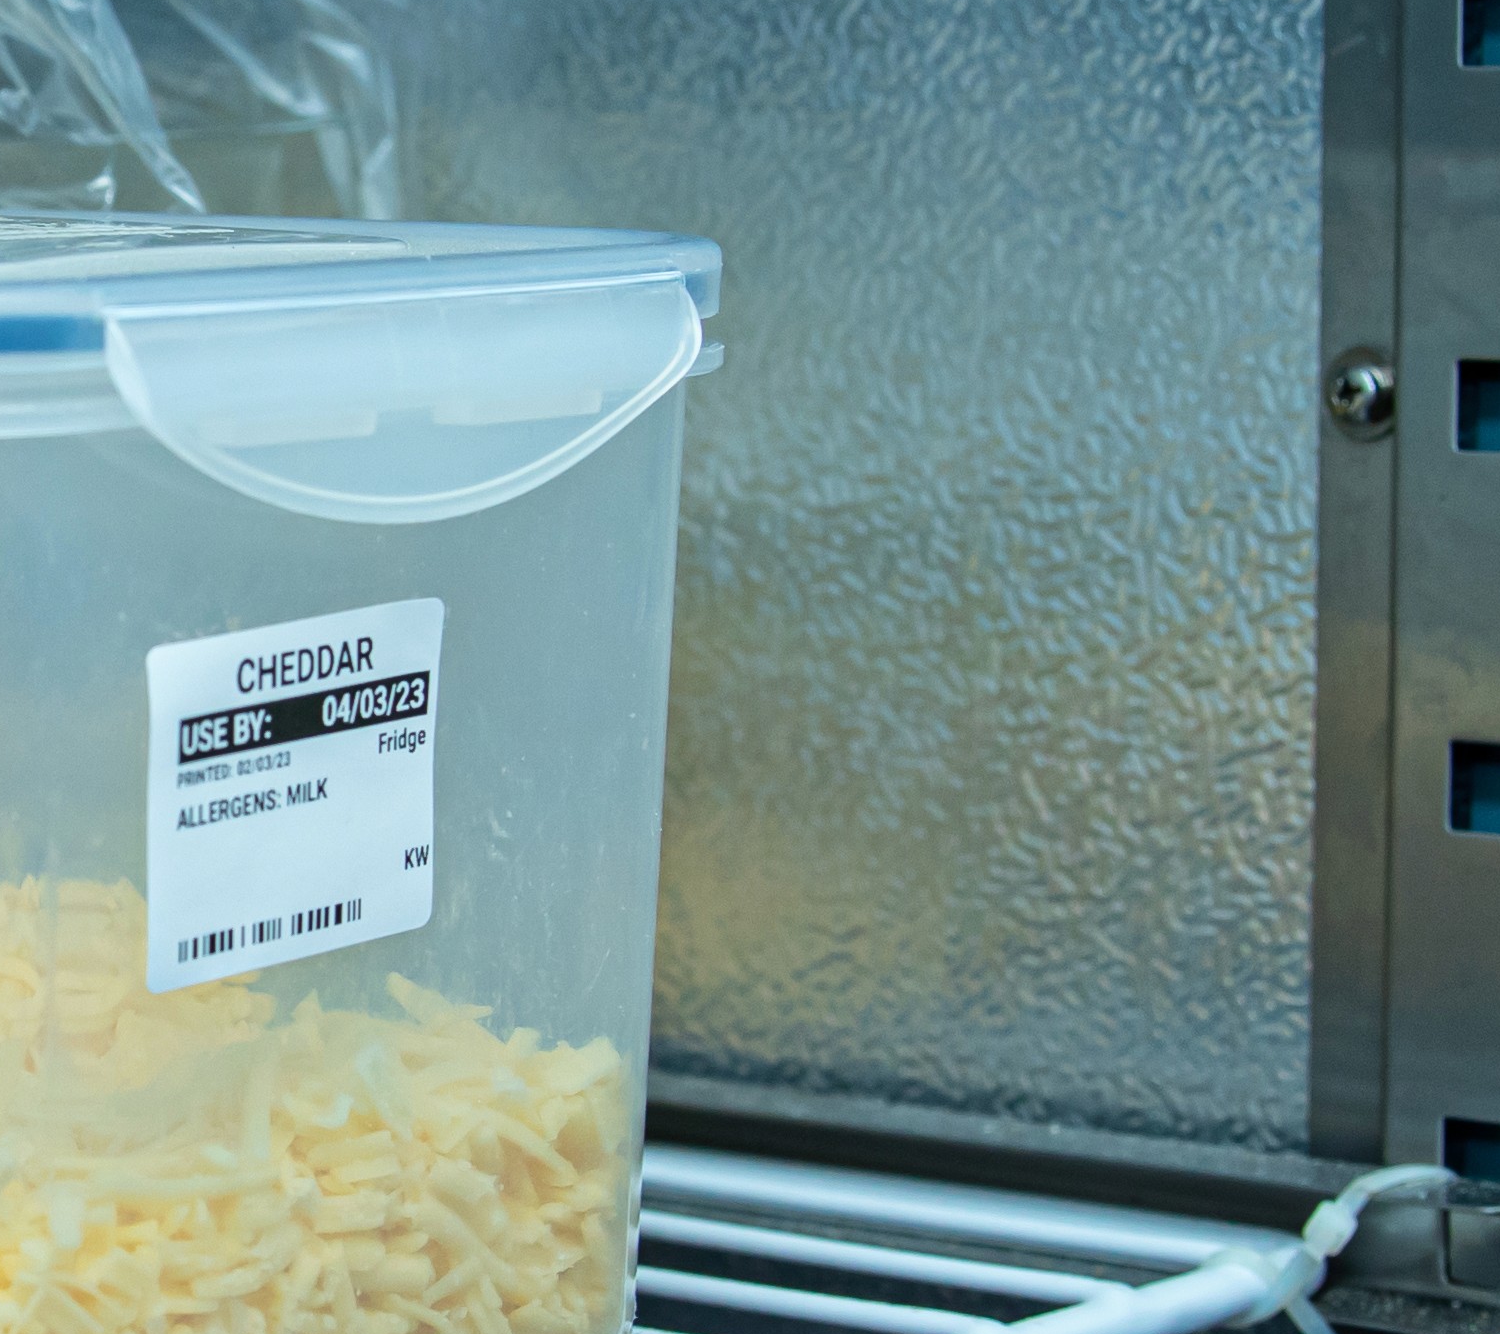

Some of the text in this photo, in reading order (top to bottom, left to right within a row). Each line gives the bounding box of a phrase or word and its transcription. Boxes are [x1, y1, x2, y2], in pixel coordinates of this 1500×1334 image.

[237, 637, 374, 693] CHEDDAR
[181, 678, 426, 756] USE BY: 04/03/23
[378, 729, 427, 755] Fridge
[177, 763, 232, 789] PRINTED:
[176, 778, 329, 831] ALLERGENS: MILK
[404, 845, 429, 871] KW
